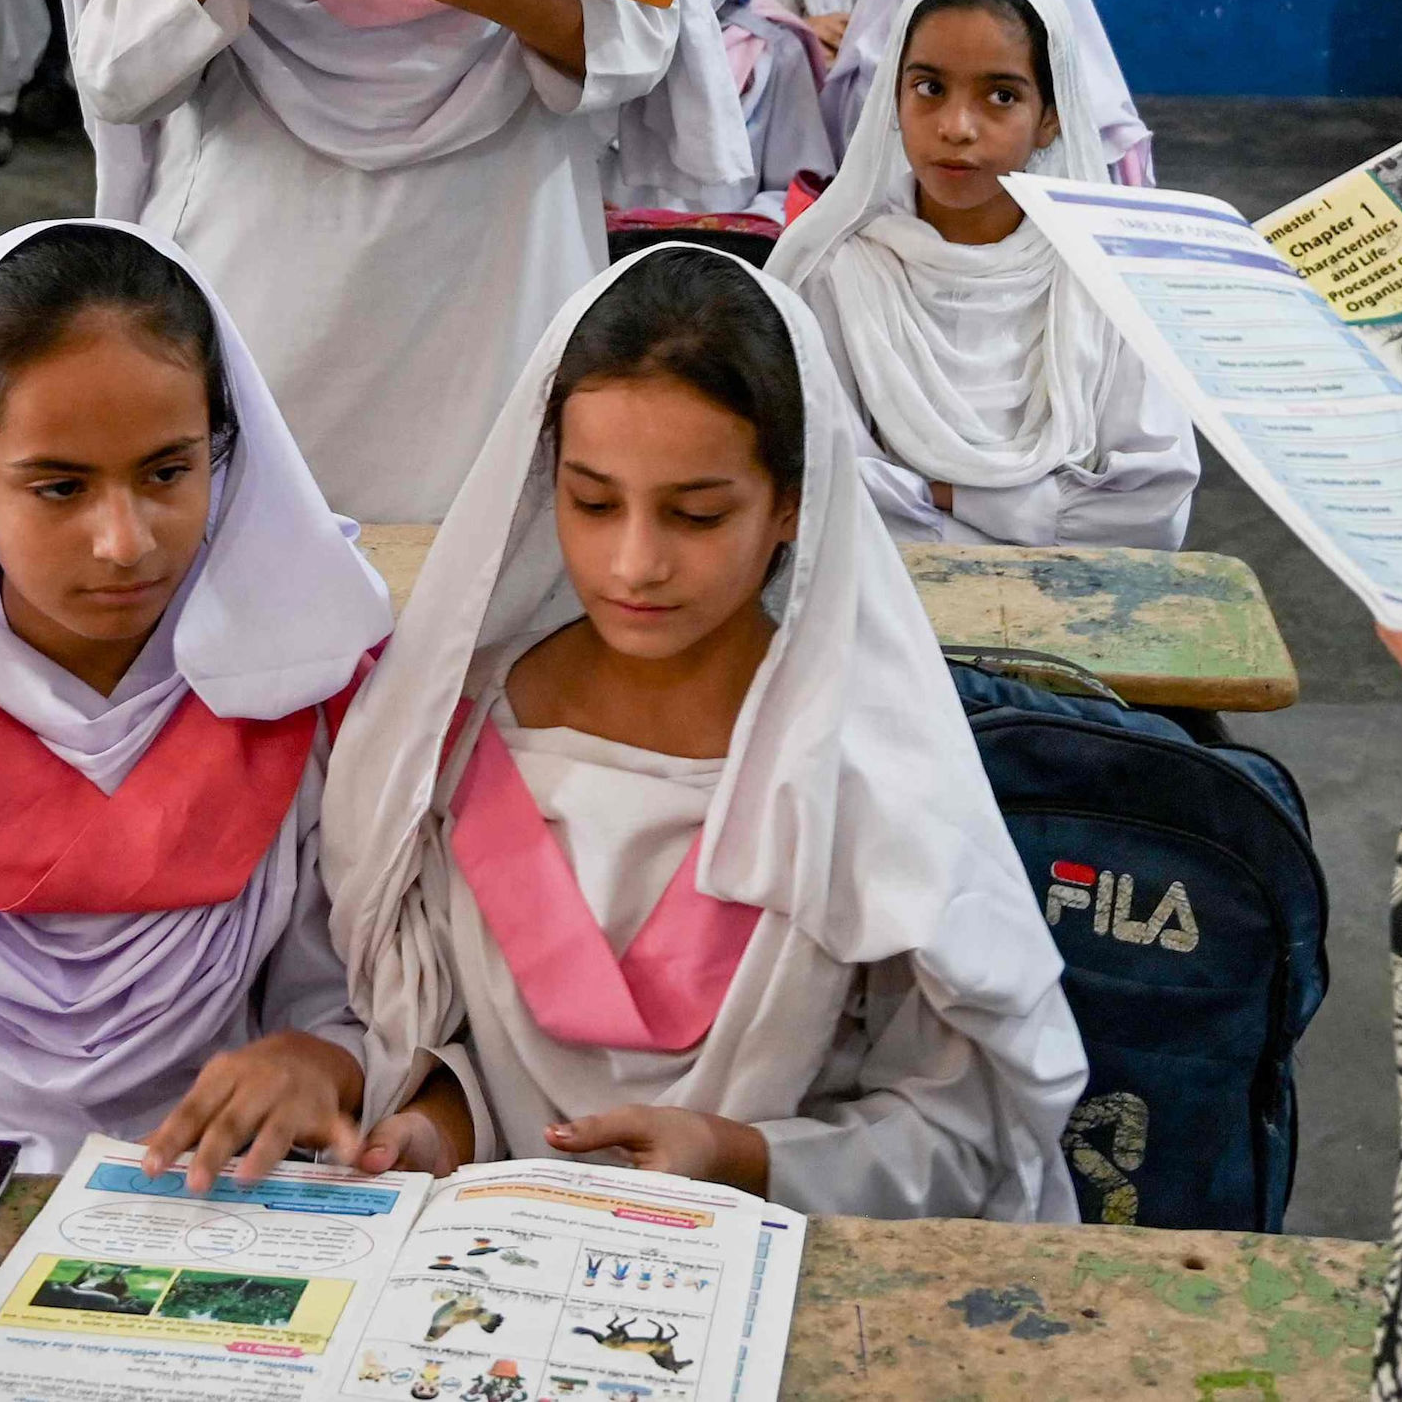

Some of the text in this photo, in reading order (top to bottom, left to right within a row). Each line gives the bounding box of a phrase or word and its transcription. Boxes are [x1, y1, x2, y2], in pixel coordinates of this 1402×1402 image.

[1264, 209, 1317, 245] emester
[1288, 202, 1376, 259] Chapter 1
[1296, 218, 1399, 280] Characteristics
[1327, 262, 1397, 303] Processes
[1331, 246, 1389, 283] and Life
[1045, 859, 1200, 953] FILA
